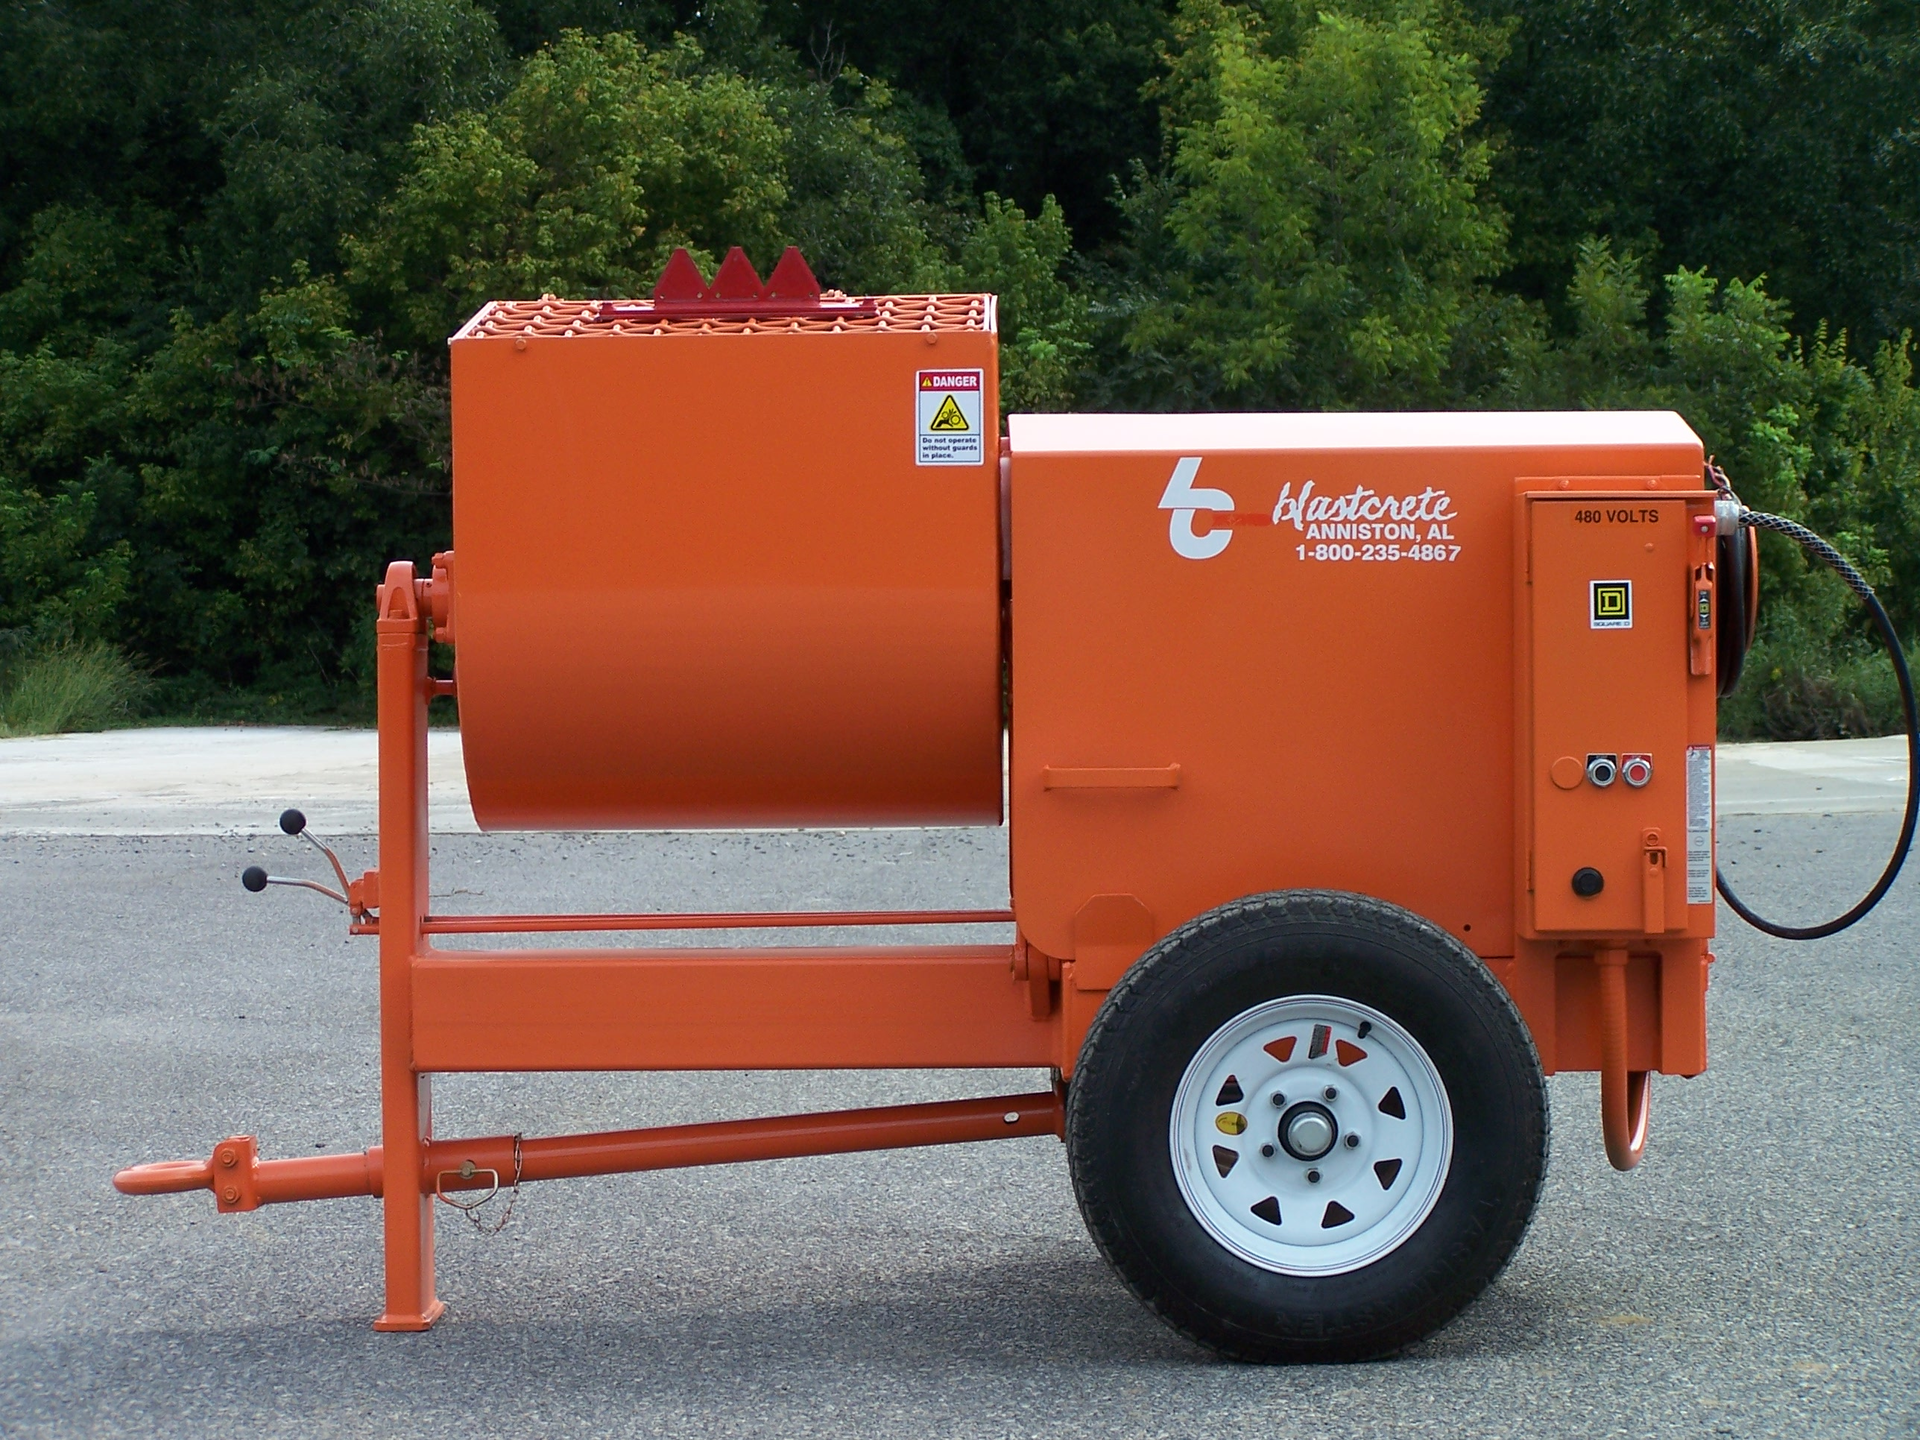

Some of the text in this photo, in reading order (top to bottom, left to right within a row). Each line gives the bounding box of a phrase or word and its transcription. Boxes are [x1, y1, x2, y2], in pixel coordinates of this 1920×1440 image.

[933, 376, 977, 387] DANGER
[1574, 509, 1659, 523] 480 VOLTS
[1305, 523, 1455, 542] ANNISTON, AL
[1295, 543, 1462, 562] 1-800-235-4867
